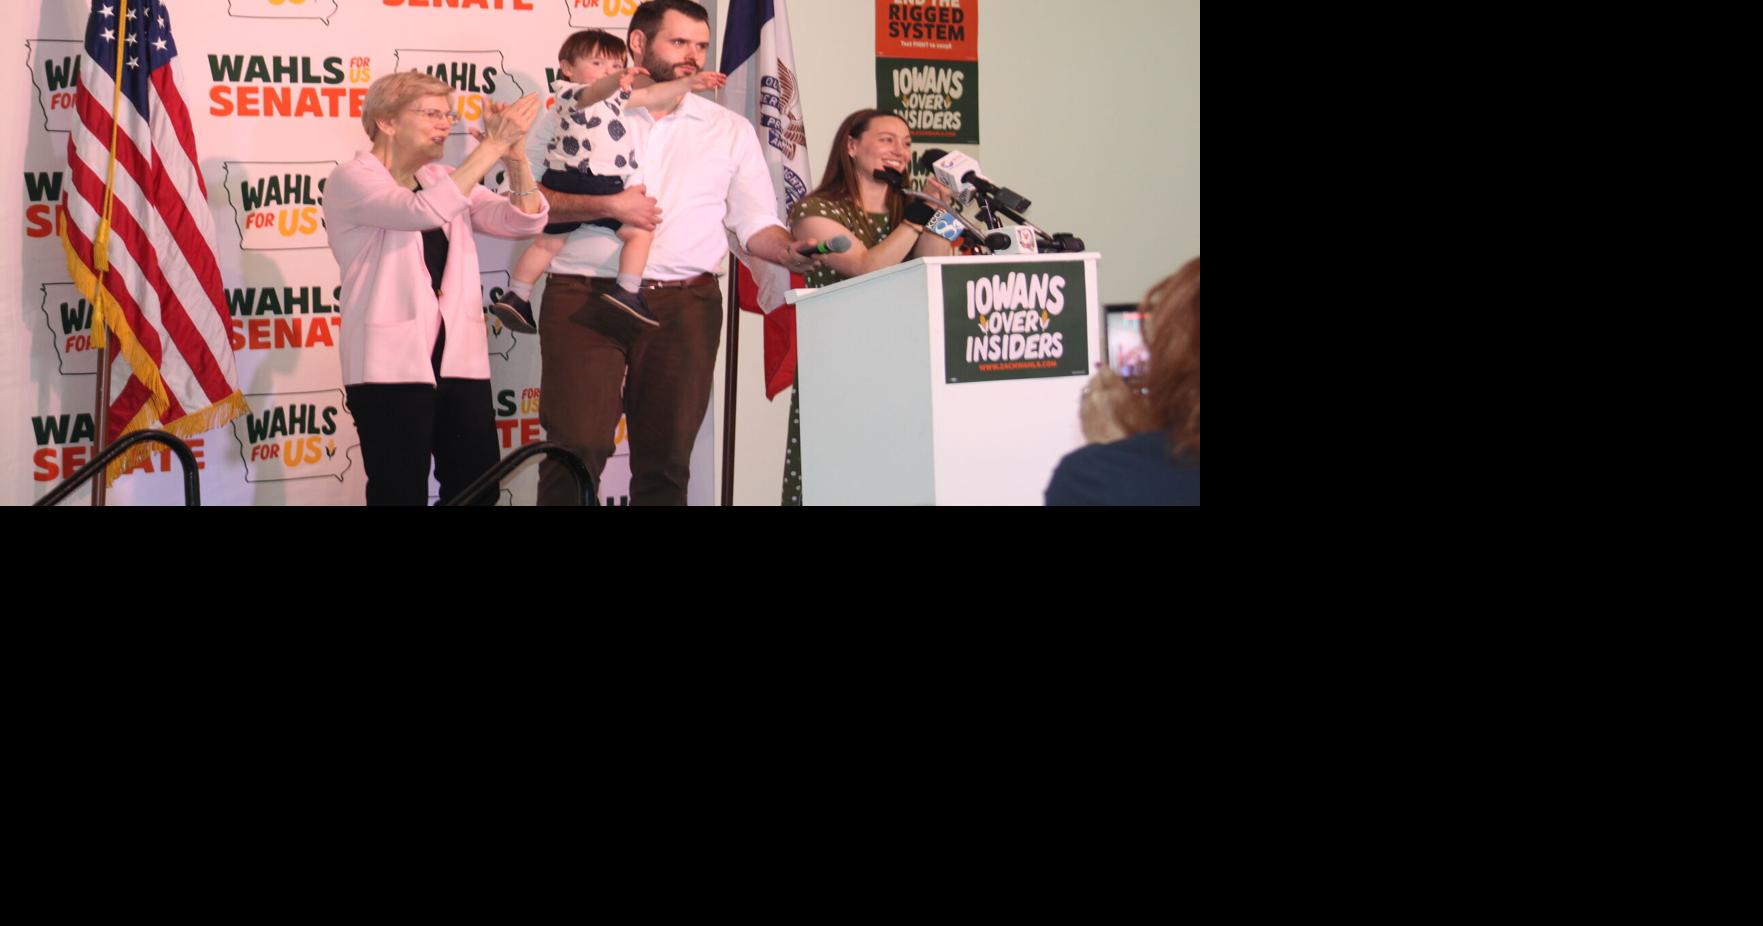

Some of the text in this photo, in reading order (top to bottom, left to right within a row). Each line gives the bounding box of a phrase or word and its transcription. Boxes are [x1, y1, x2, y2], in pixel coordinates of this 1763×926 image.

[889, 4, 965, 23] RIGGED
[889, 22, 965, 41] SYSTEM
[208, 54, 345, 84] WAHLS
[351, 57, 370, 67] FOR
[351, 68, 371, 83] US
[427, 62, 497, 94] AHLS
[892, 65, 965, 99] IOWANS
[51, 92, 77, 110] FO
[209, 85, 369, 118] SENATE
[909, 93, 944, 110] OVER
[245, 207, 318, 237] FOR US
[966, 271, 1066, 320] IOWANS
[988, 310, 1039, 334] OVER
[966, 332, 1063, 363] INSIDERS
[247, 403, 338, 444] WAHLS
[251, 436, 322, 468] FOR US
